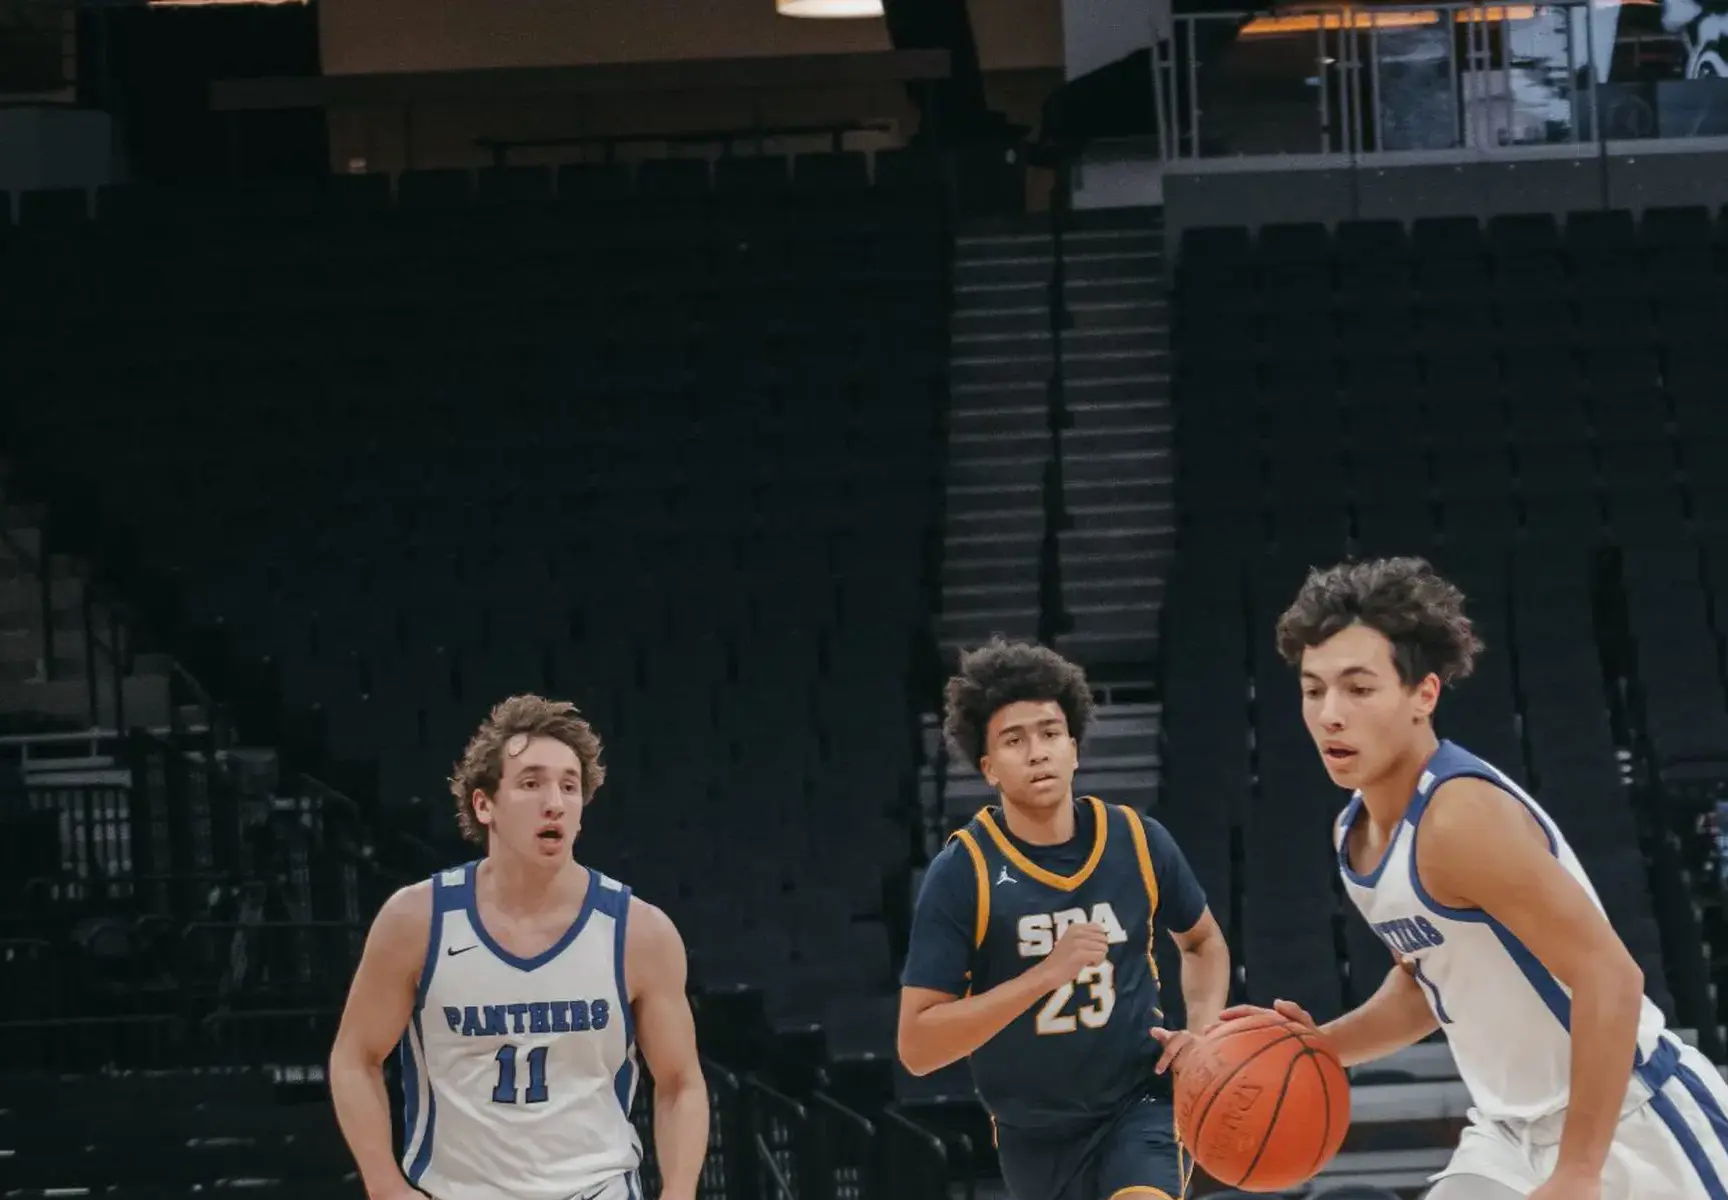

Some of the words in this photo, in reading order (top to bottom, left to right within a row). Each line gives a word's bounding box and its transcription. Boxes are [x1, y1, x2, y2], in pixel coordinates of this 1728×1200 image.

[443, 998, 610, 1036] PANTHERS
[1035, 959, 1116, 1035] 23
[492, 1043, 549, 1104] 11
